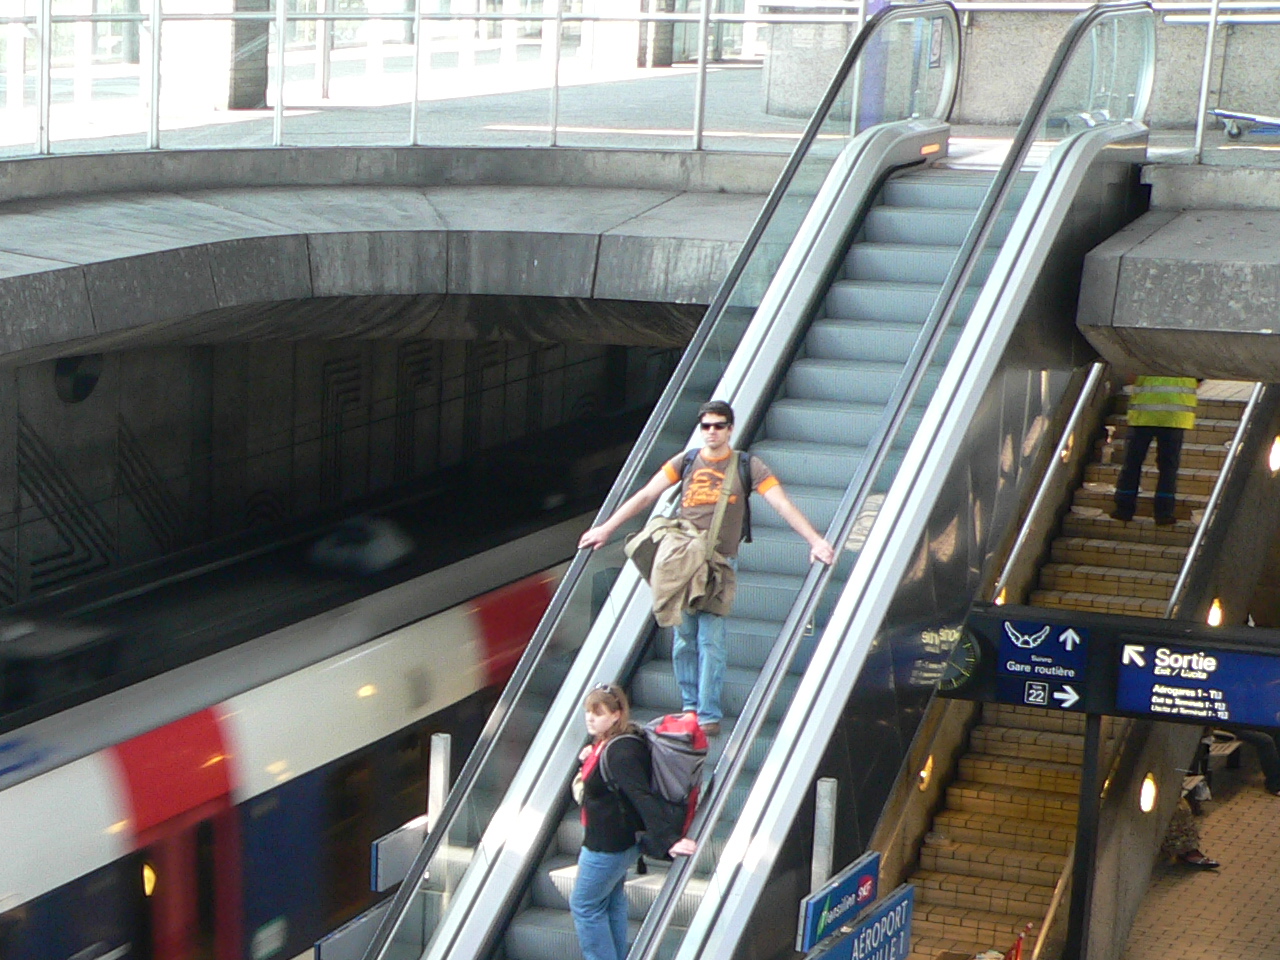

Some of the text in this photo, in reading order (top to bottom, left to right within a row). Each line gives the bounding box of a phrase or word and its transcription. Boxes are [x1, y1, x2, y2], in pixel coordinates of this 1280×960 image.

[1006, 660, 1075, 677] Gare routière
[1155, 647, 1218, 671] Sortie
[1028, 689, 1045, 702] 22
[900, 931, 904, 954] 1
